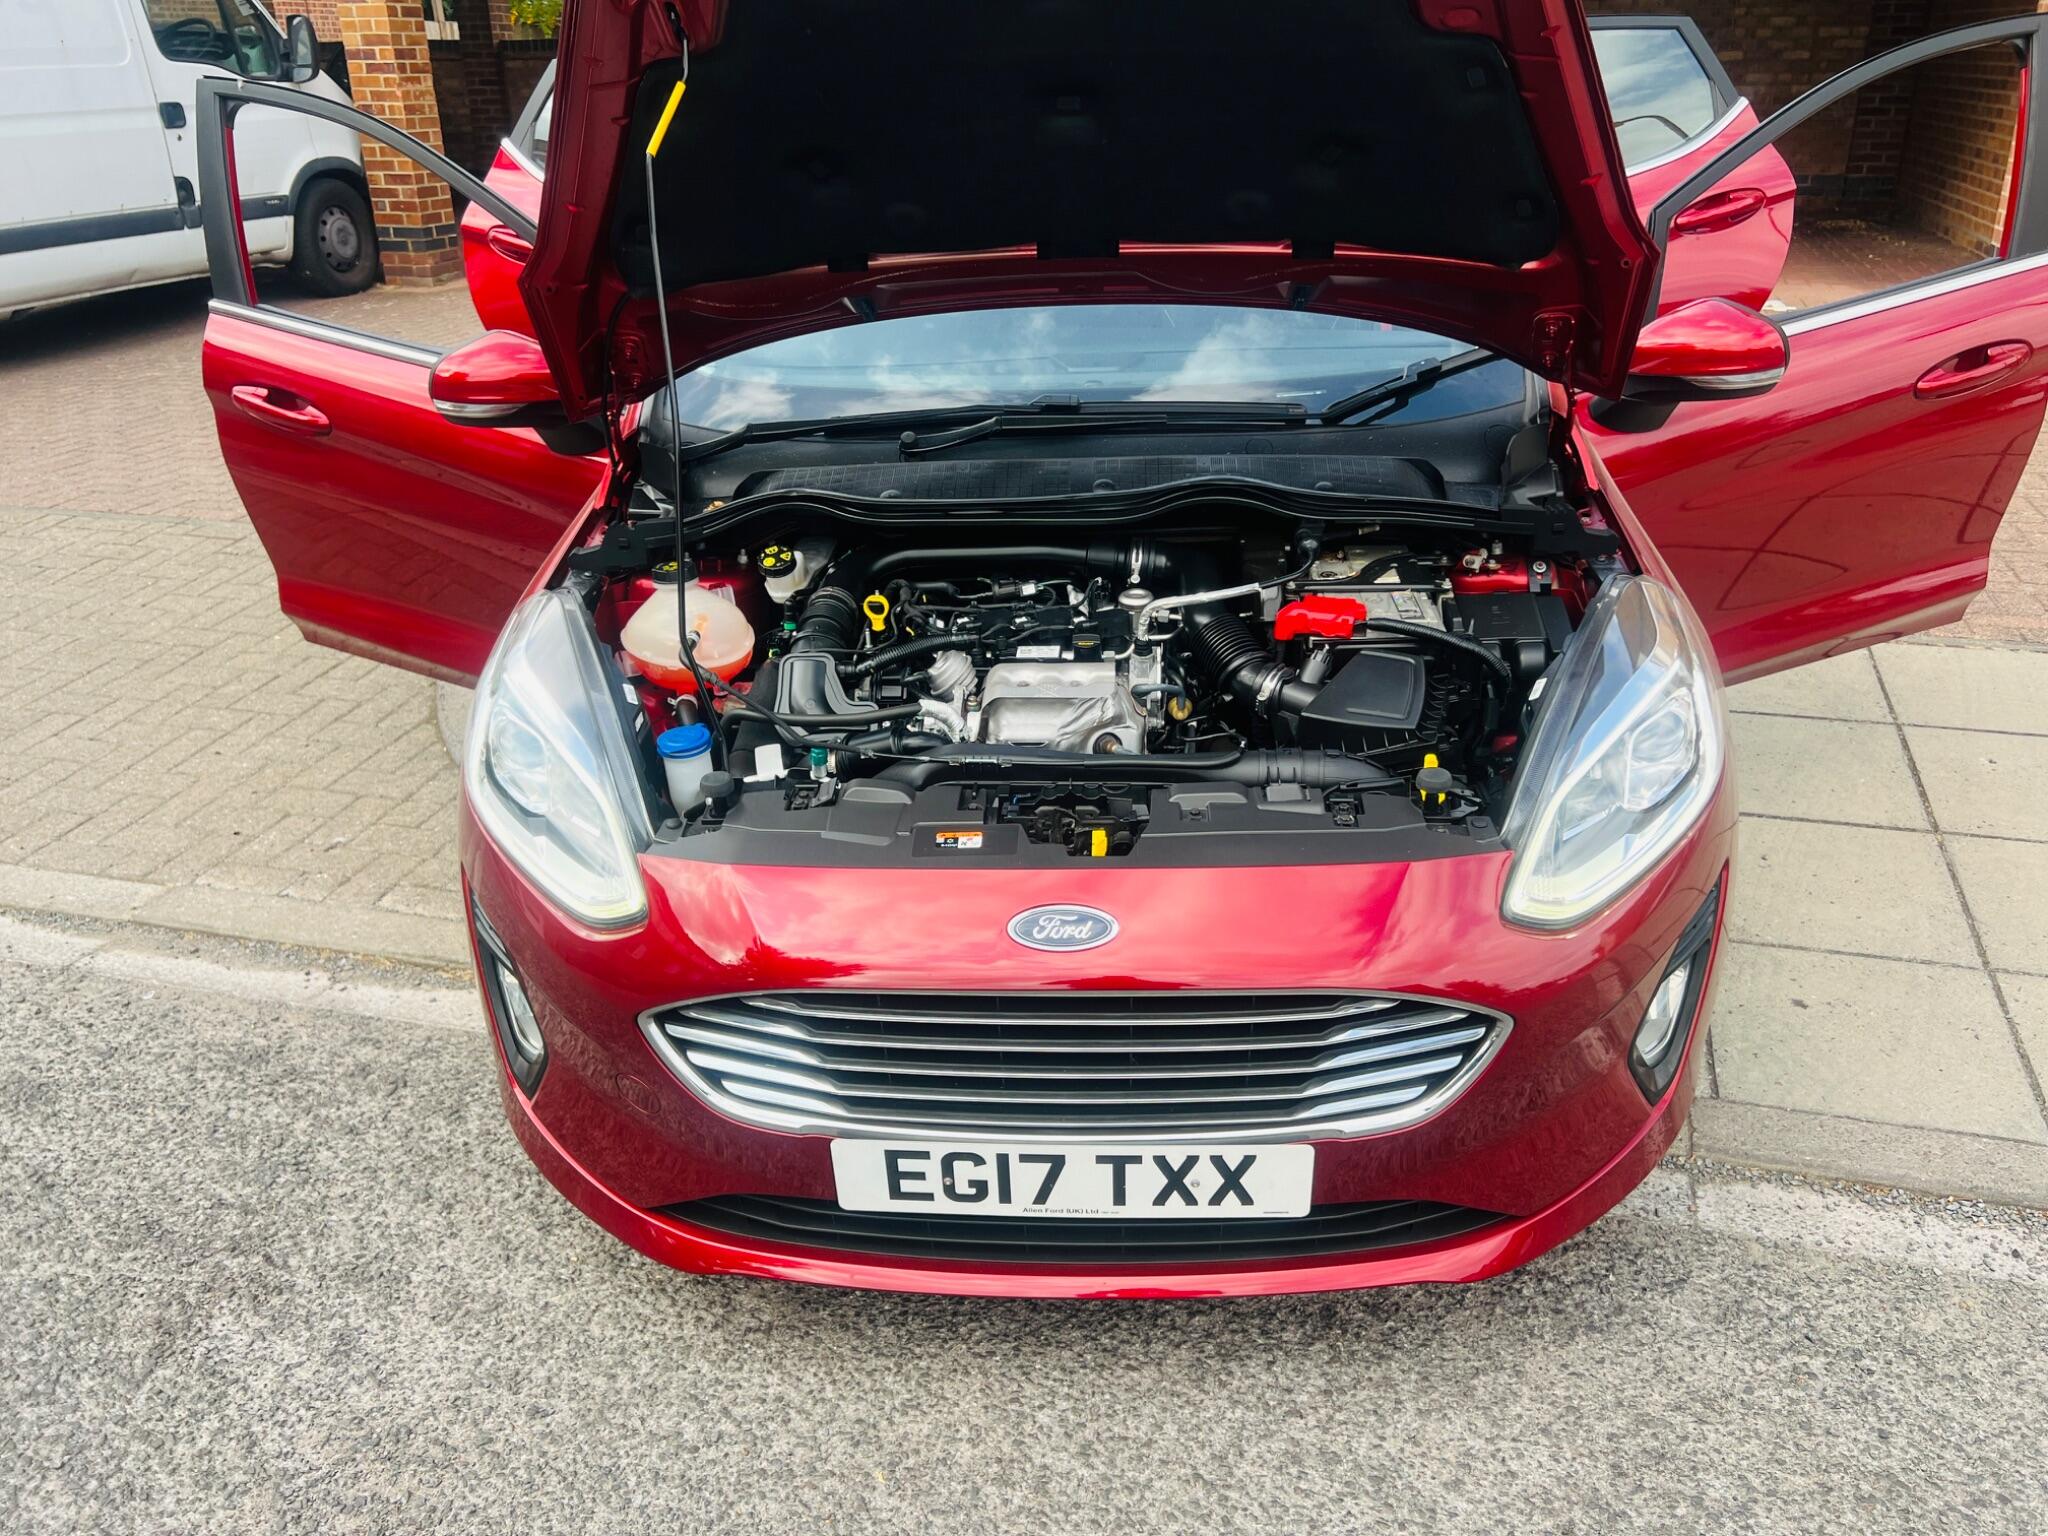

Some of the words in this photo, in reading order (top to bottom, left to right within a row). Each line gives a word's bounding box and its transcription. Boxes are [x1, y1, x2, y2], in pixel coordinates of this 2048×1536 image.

[1032, 914, 1094, 939] Ford
[884, 1149, 1067, 1206] EG17
[1095, 1154, 1258, 1207] TXX
